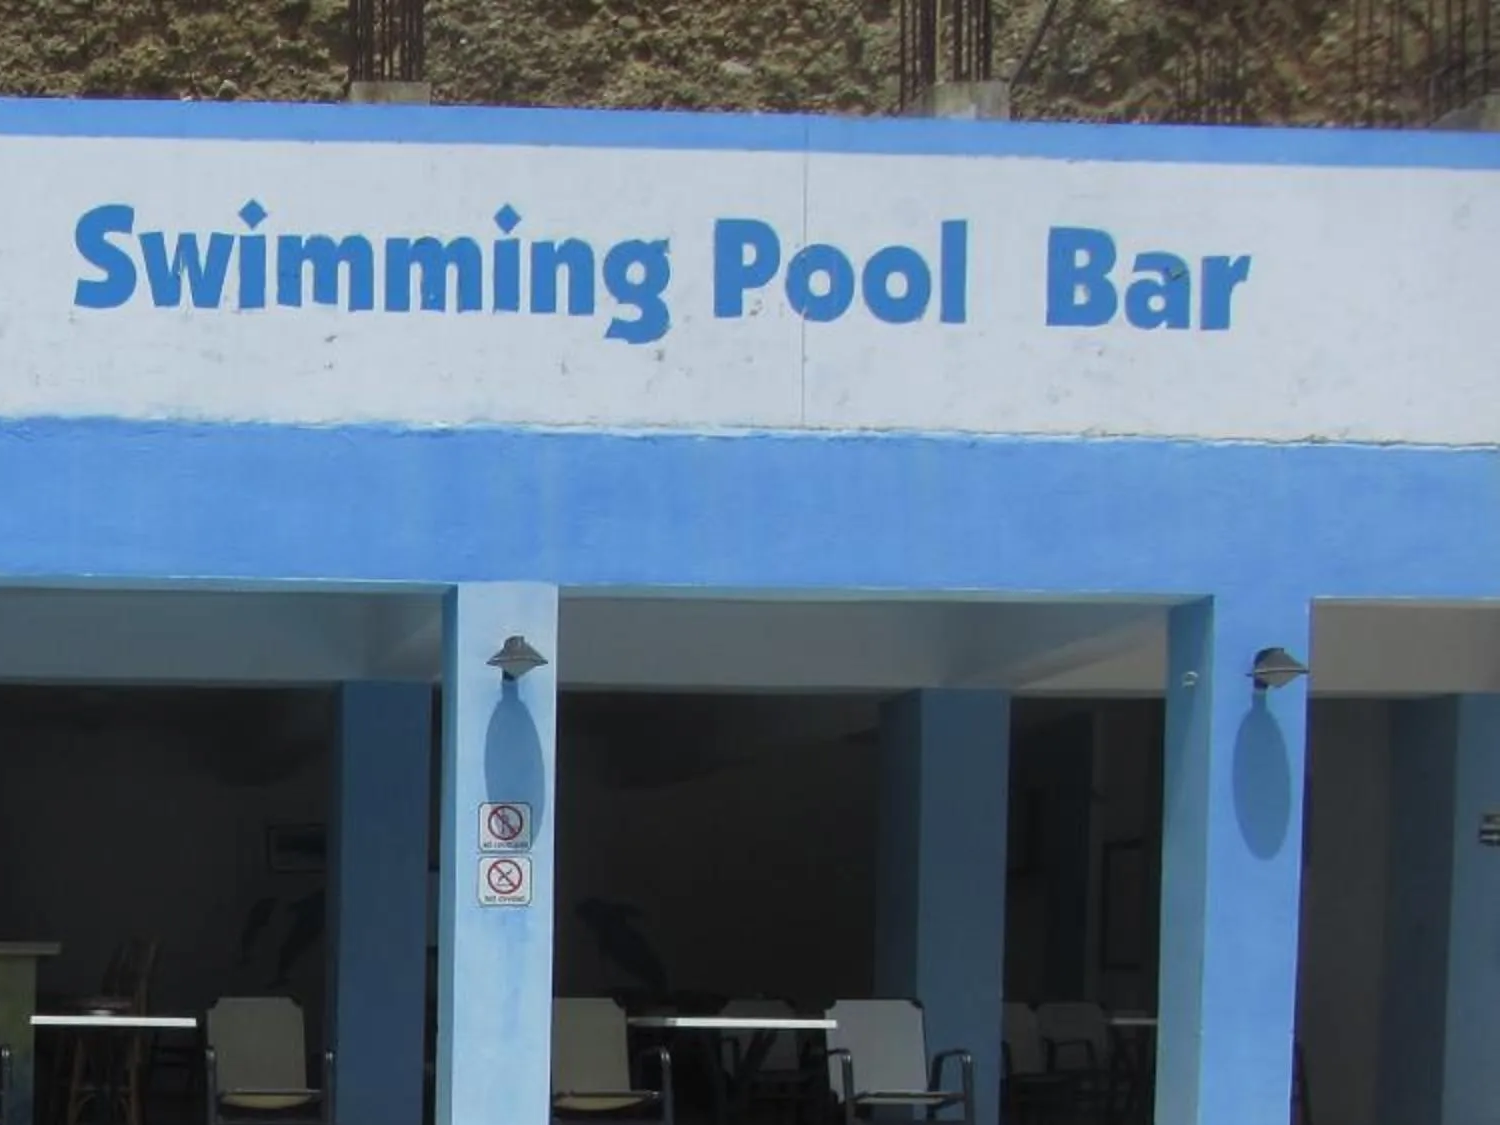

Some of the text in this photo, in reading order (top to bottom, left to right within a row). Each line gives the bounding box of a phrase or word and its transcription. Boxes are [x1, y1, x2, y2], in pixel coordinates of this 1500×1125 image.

[74, 200, 1252, 345] Swimming Pool Bar
